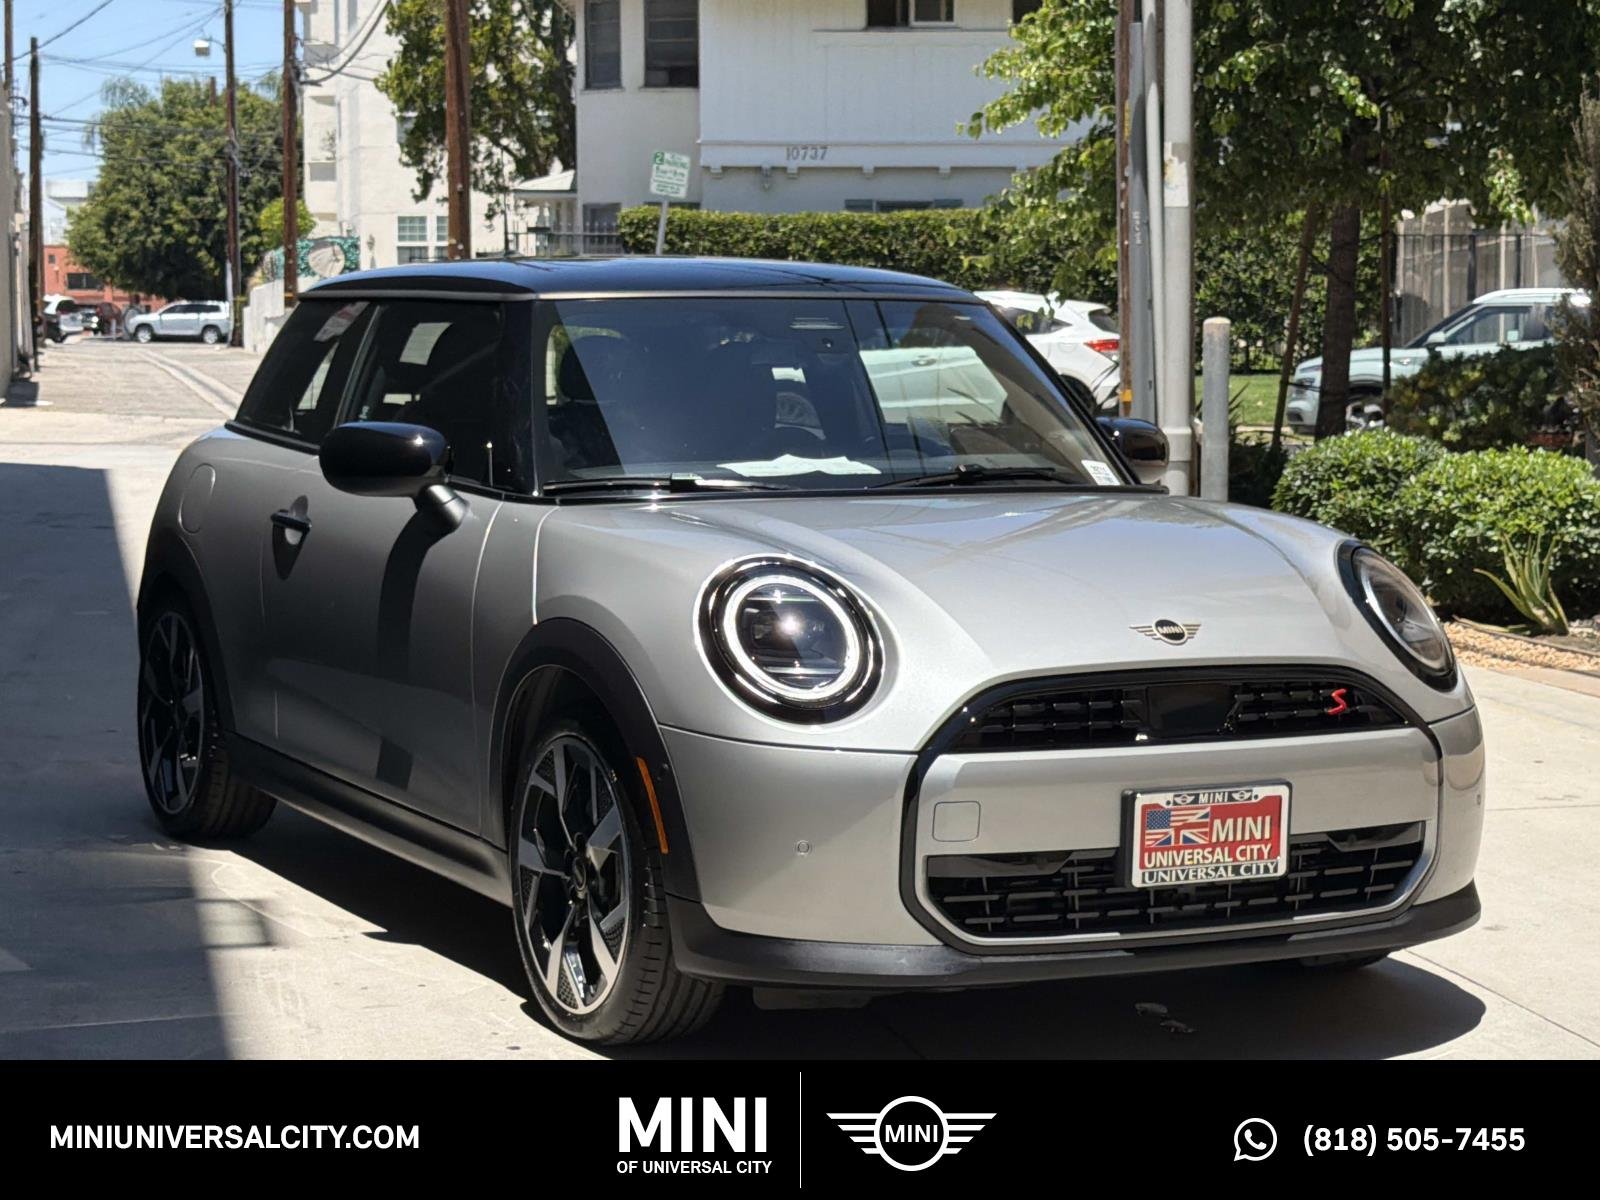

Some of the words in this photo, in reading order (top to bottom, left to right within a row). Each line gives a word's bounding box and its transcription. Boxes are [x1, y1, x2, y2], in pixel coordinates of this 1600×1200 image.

[786, 146, 828, 161] 10737
[1157, 625, 1183, 634] MINI
[1328, 688, 1347, 715] S
[1198, 791, 1229, 804] MINI
[1211, 815, 1271, 843] MINI
[1144, 848, 1234, 868] UNIVERSAL
[1235, 843, 1272, 862] CITY
[1144, 865, 1236, 884] UNIVERSAL
[1239, 862, 1279, 877] CITY
